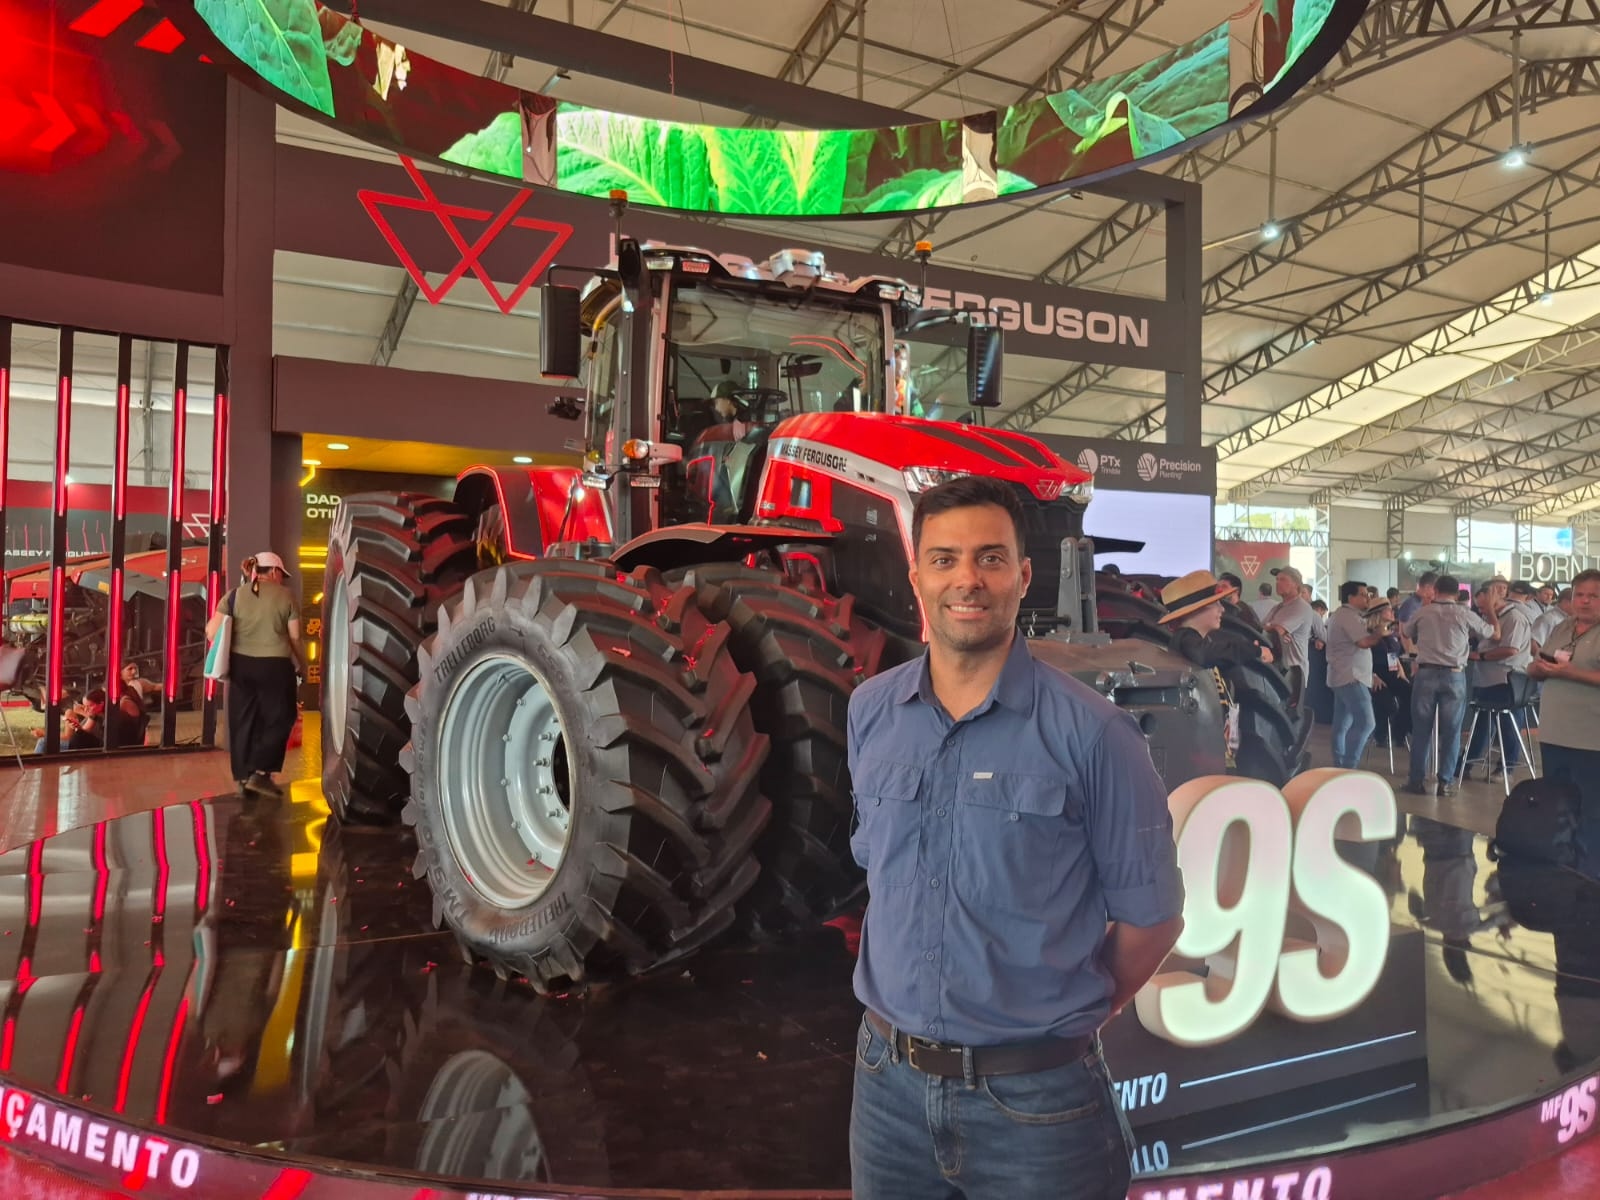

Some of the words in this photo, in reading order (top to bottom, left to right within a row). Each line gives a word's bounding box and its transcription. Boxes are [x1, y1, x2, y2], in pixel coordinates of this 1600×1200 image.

[922, 285, 1149, 348] ERGUSON
[803, 447, 848, 472] FERGUSON
[1159, 458, 1202, 472] Precision
[306, 493, 342, 506] DAD
[4, 549, 43, 557] ASSEY
[1519, 554, 1587, 581] BORN
[433, 615, 498, 684] TRELLEBORG
[0, 1086, 201, 1190] ÇAMENTO
